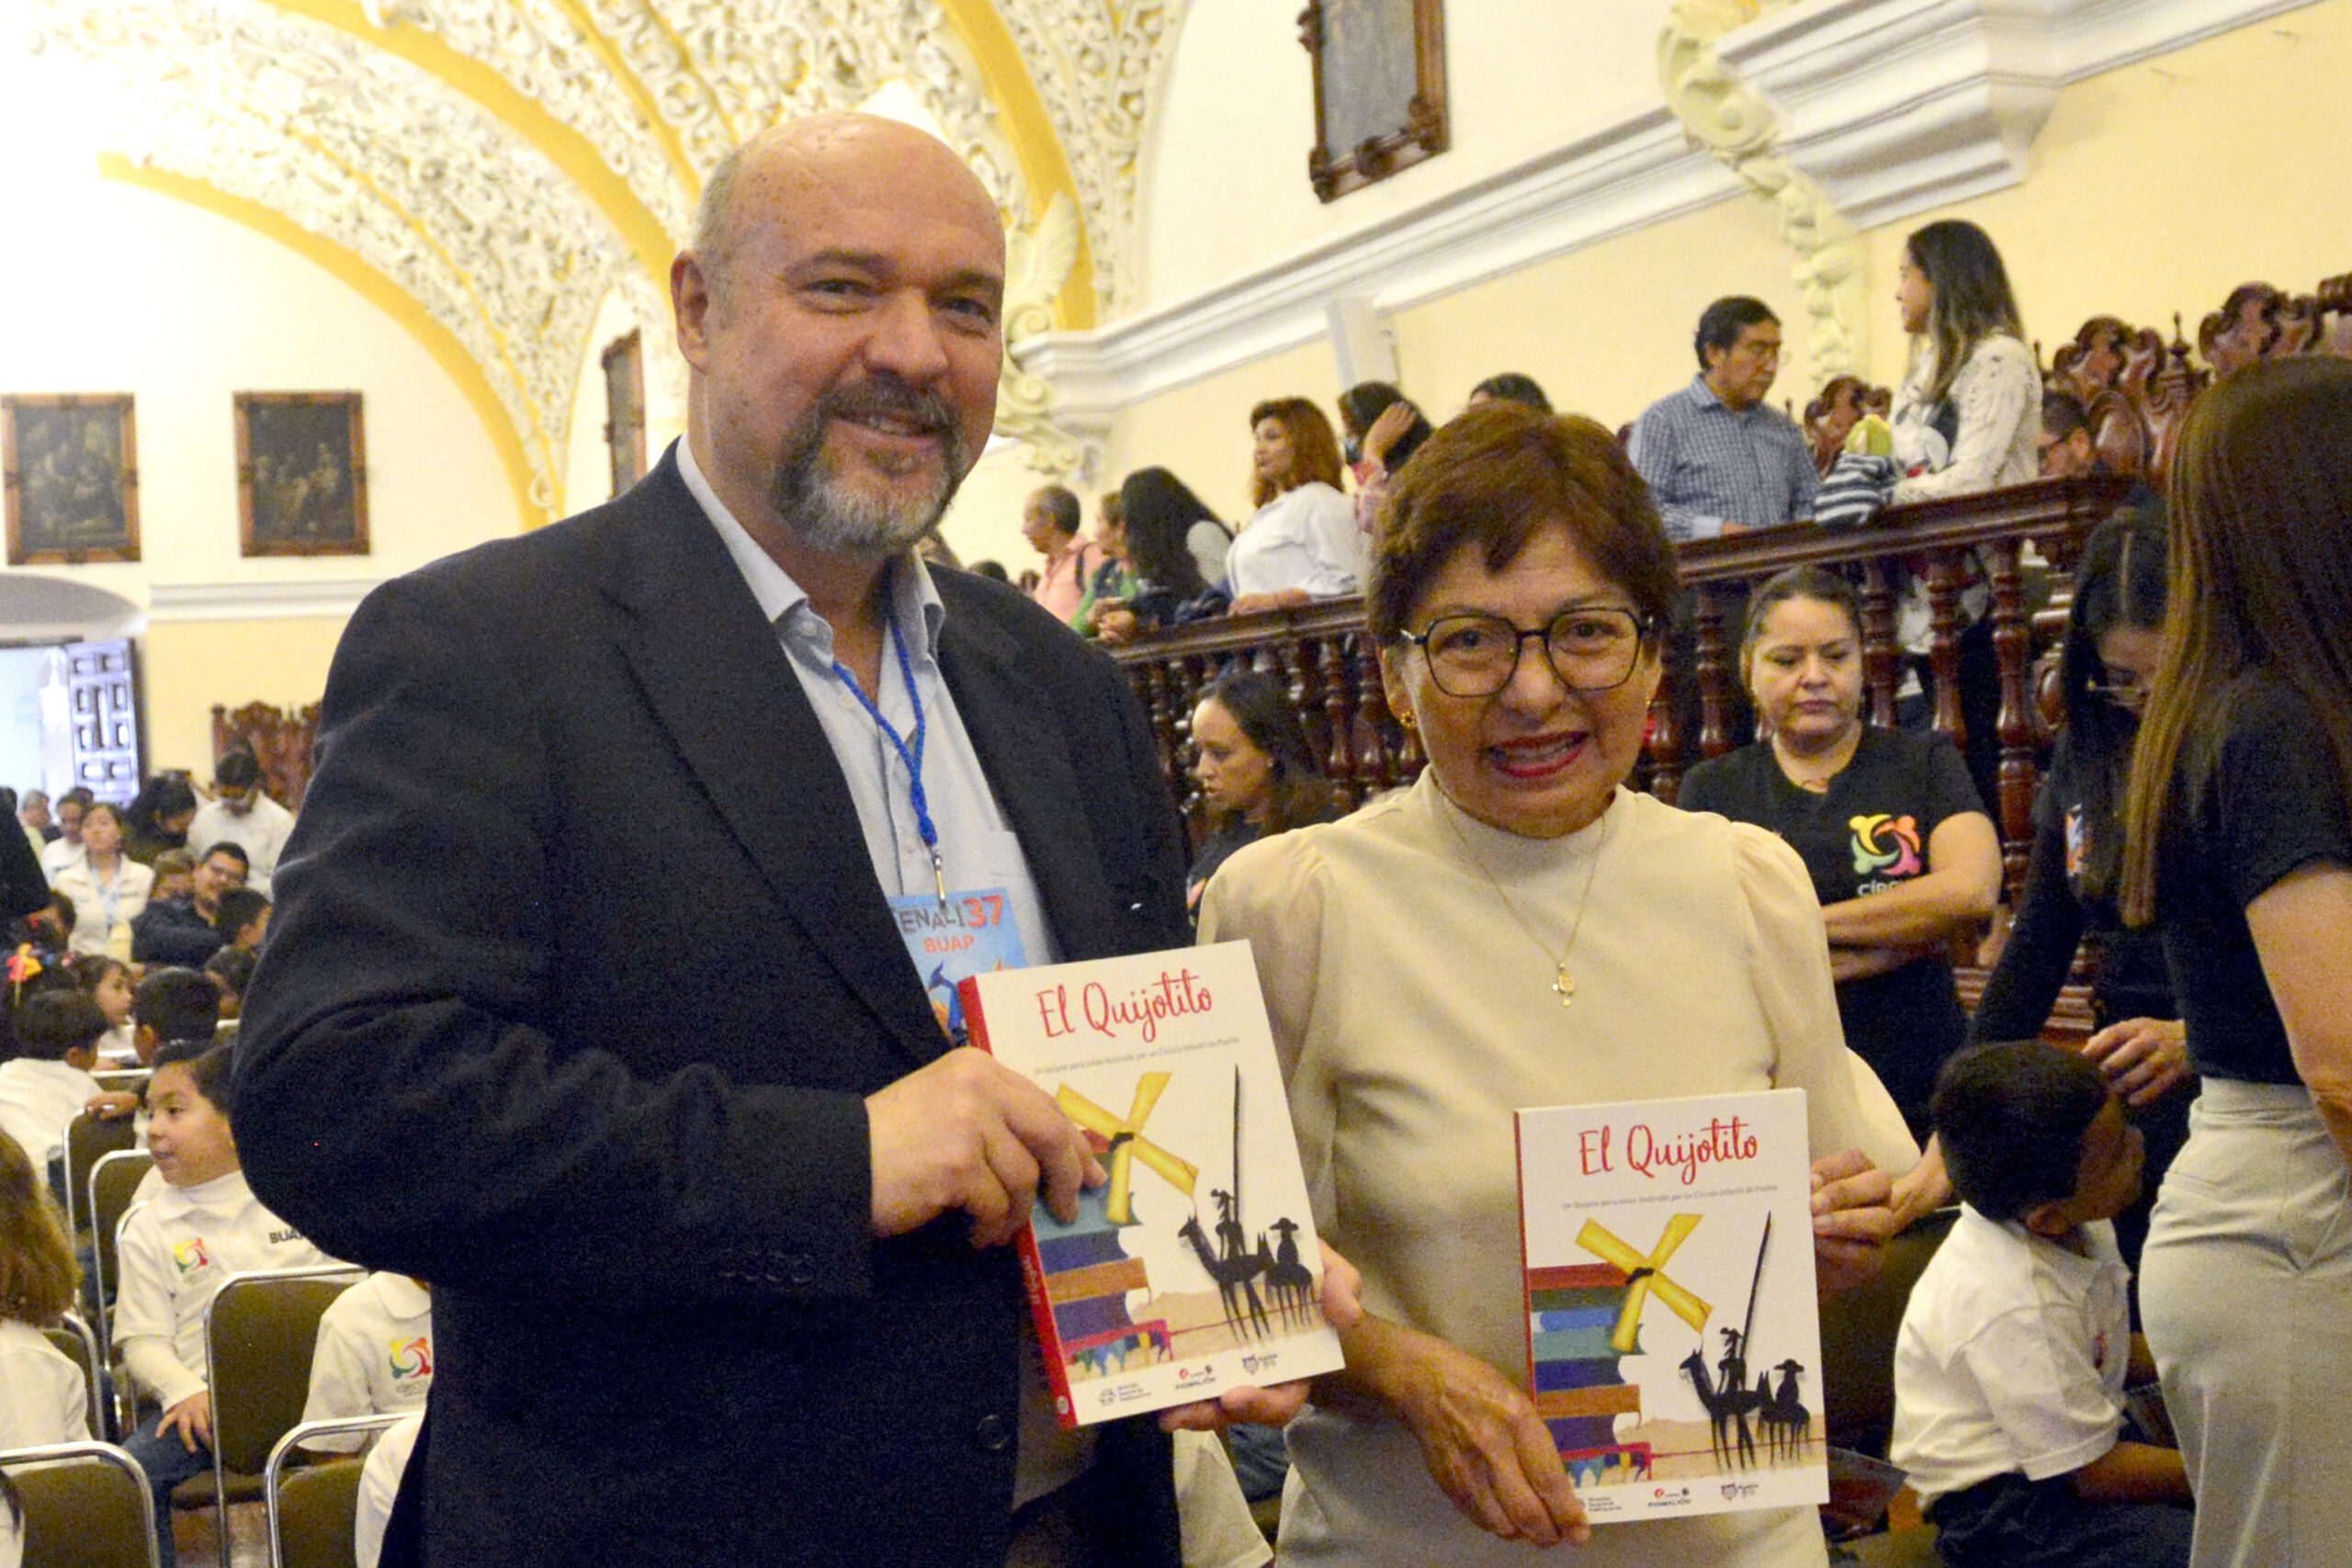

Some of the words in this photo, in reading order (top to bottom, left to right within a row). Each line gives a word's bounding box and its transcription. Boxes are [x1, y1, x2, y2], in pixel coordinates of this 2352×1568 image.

[924, 933, 975, 953] BUAP
[1036, 984, 1076, 1038] El
[1083, 968, 1213, 1043] Quijotito
[1579, 1125, 1614, 1175] El
[1626, 1115, 1758, 1185] Quijotito
[269, 1228, 303, 1244] BUA
